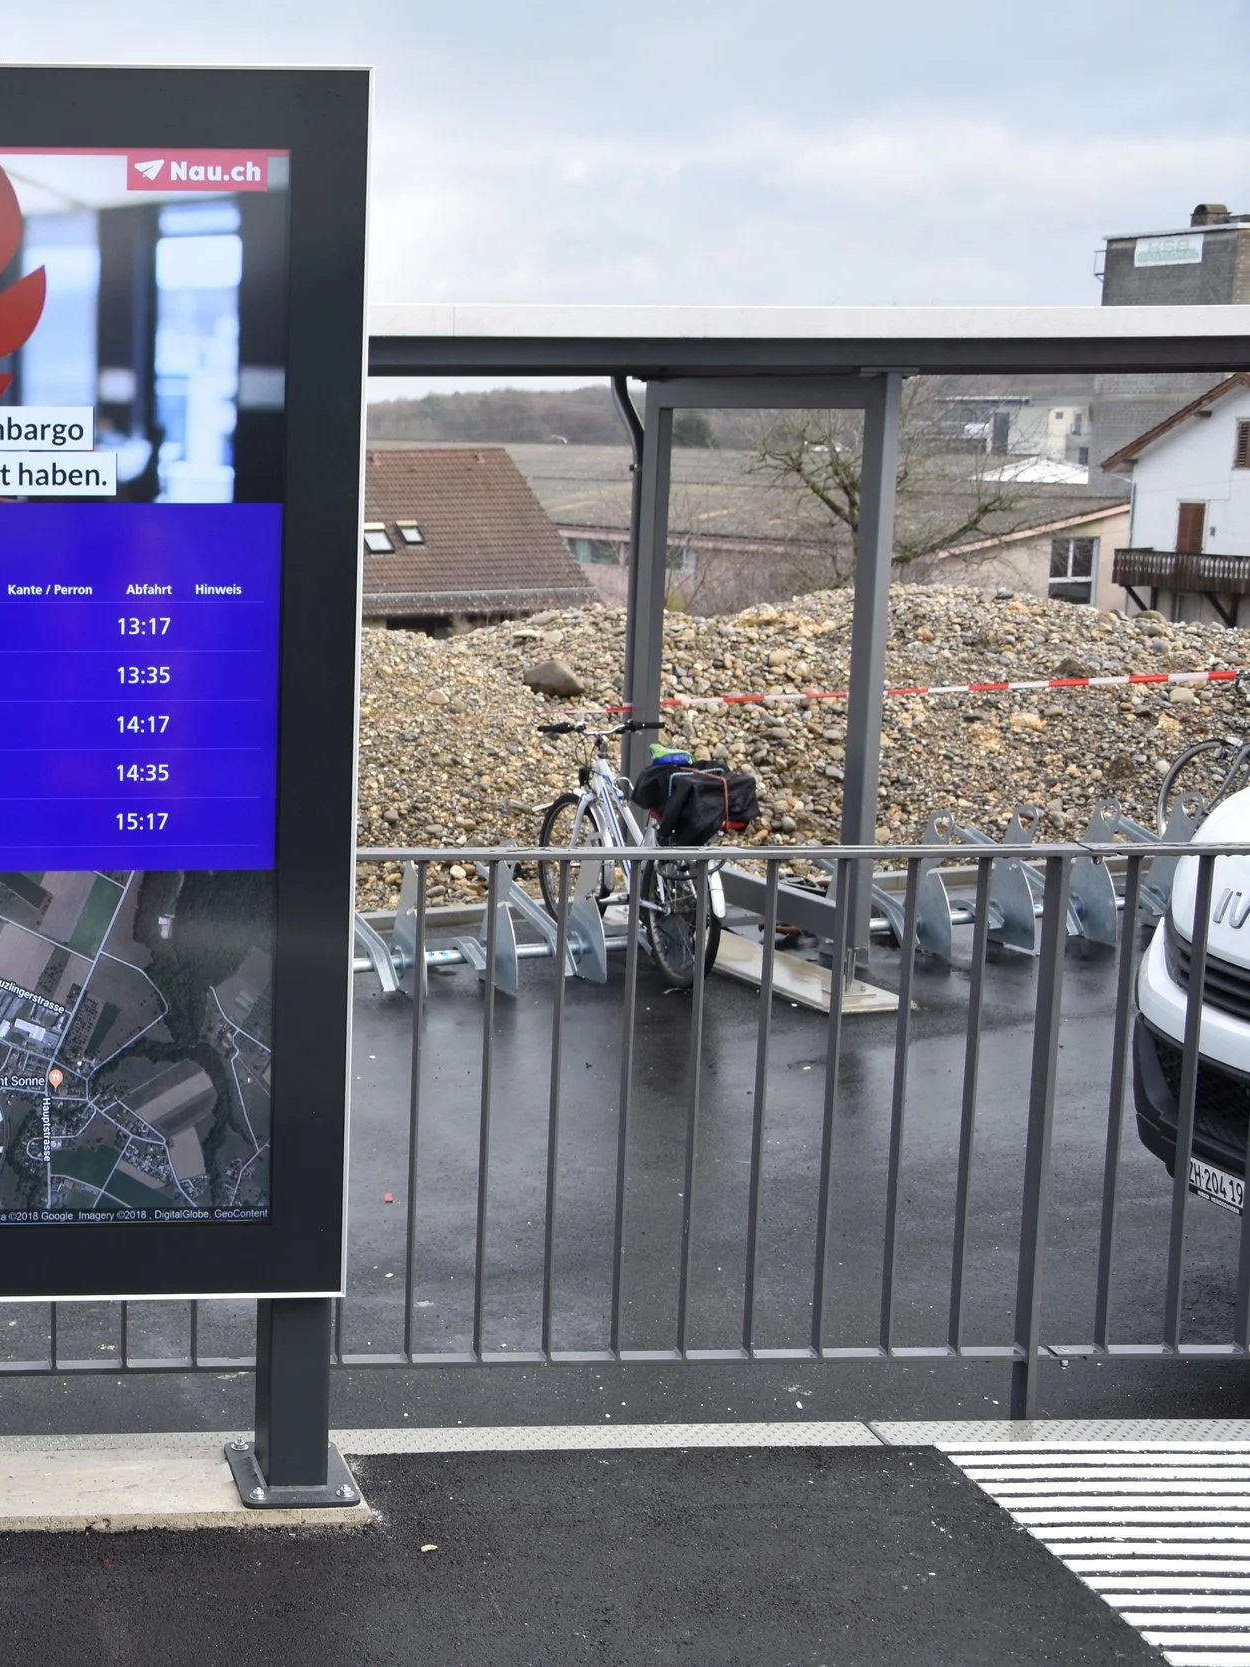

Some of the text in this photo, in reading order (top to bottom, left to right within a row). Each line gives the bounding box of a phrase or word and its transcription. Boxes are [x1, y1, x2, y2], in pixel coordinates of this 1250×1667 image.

[170, 161, 261, 182] Nau.ch
[18, 461, 108, 486] haben.
[7, 584, 43, 595] Kante
[53, 584, 93, 595] Perron
[125, 583, 173, 595] Abfahrt
[195, 583, 242, 595] Hinweis
[117, 616, 171, 635] 13:17
[117, 665, 171, 684] 13:35
[117, 715, 171, 734] 14:17
[116, 763, 170, 783] 14:35
[116, 813, 170, 832] 15:17
[11, 1076, 45, 1087] Sonne
[42, 1097, 52, 1163] Hauptstrasse
[41, 1211, 74, 1222] Google
[78, 1210, 115, 1222] Imagery
[214, 1208, 268, 1219] GeoContent
